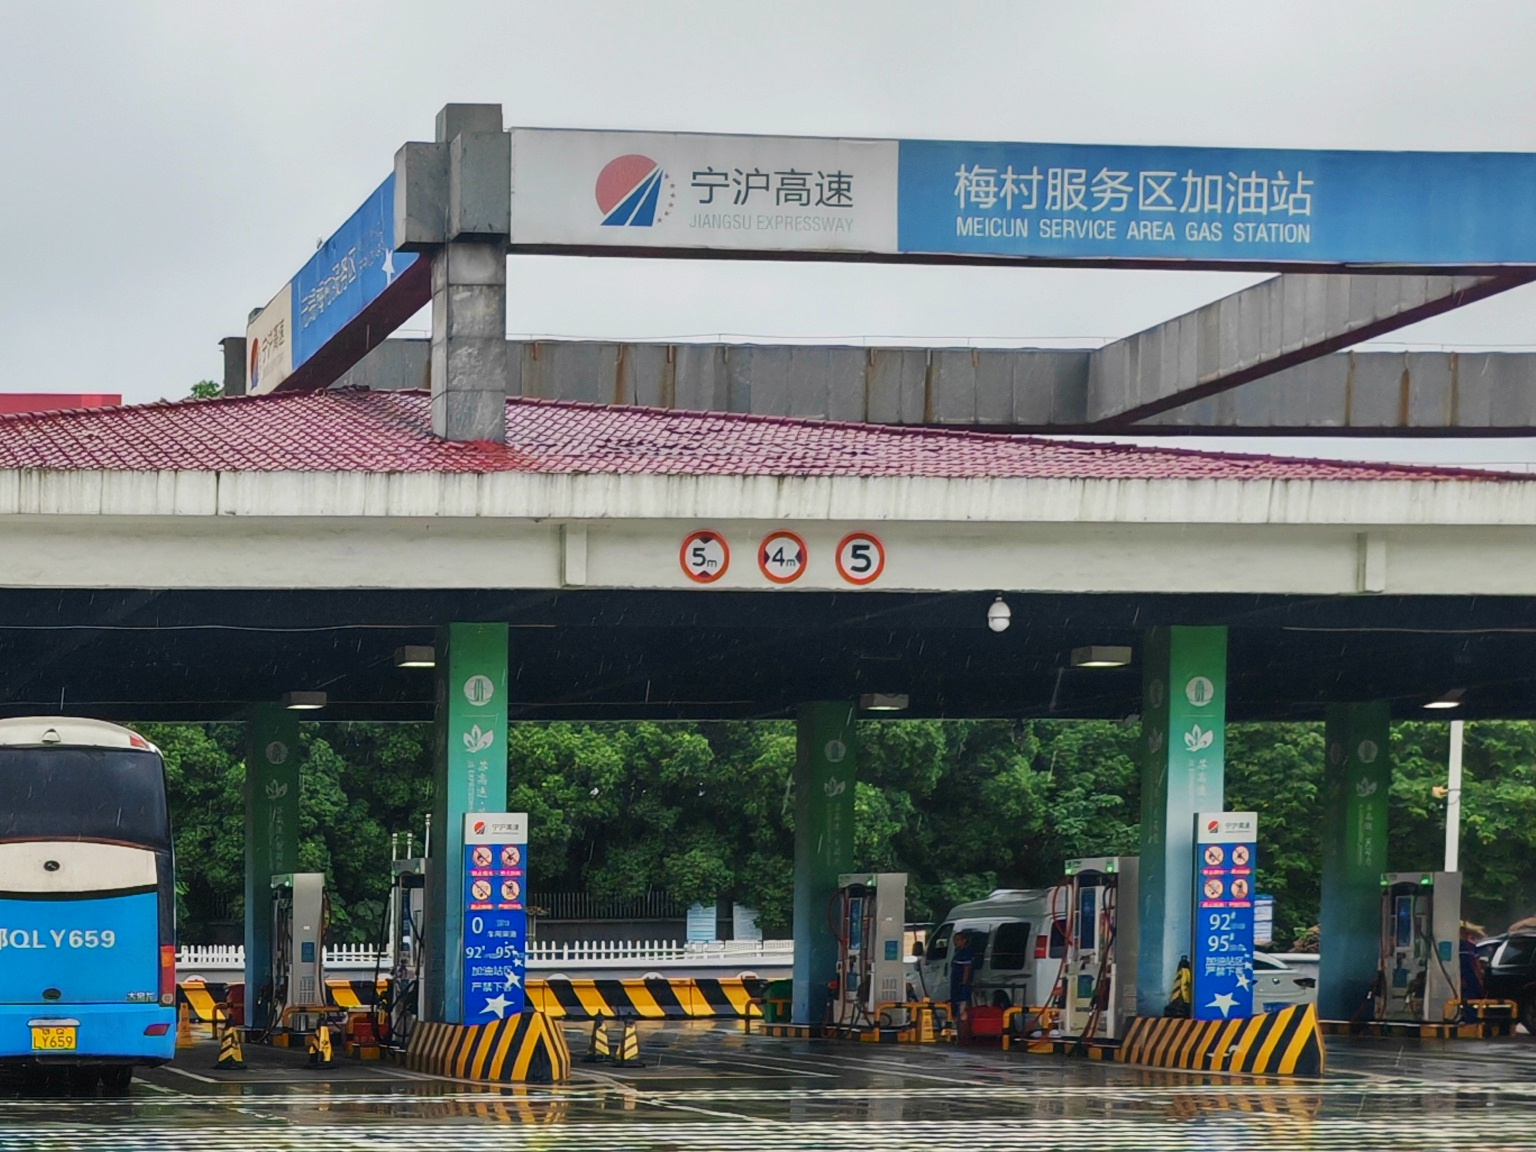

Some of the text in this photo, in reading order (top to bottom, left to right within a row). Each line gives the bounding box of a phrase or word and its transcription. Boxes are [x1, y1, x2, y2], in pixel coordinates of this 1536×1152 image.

[690, 166, 854, 208] 宁沪高速
[954, 163, 1315, 217] 梅村服务区加油站
[689, 213, 854, 233] JIANGSU EXPRESSWAY
[956, 217, 1311, 244] MEICUN SERVICE AREA GAS STATION
[691, 547, 718, 568] 5m
[771, 546, 796, 568] 4m
[850, 544, 872, 573] 5
[34, 1035, 73, 1048] LY659
